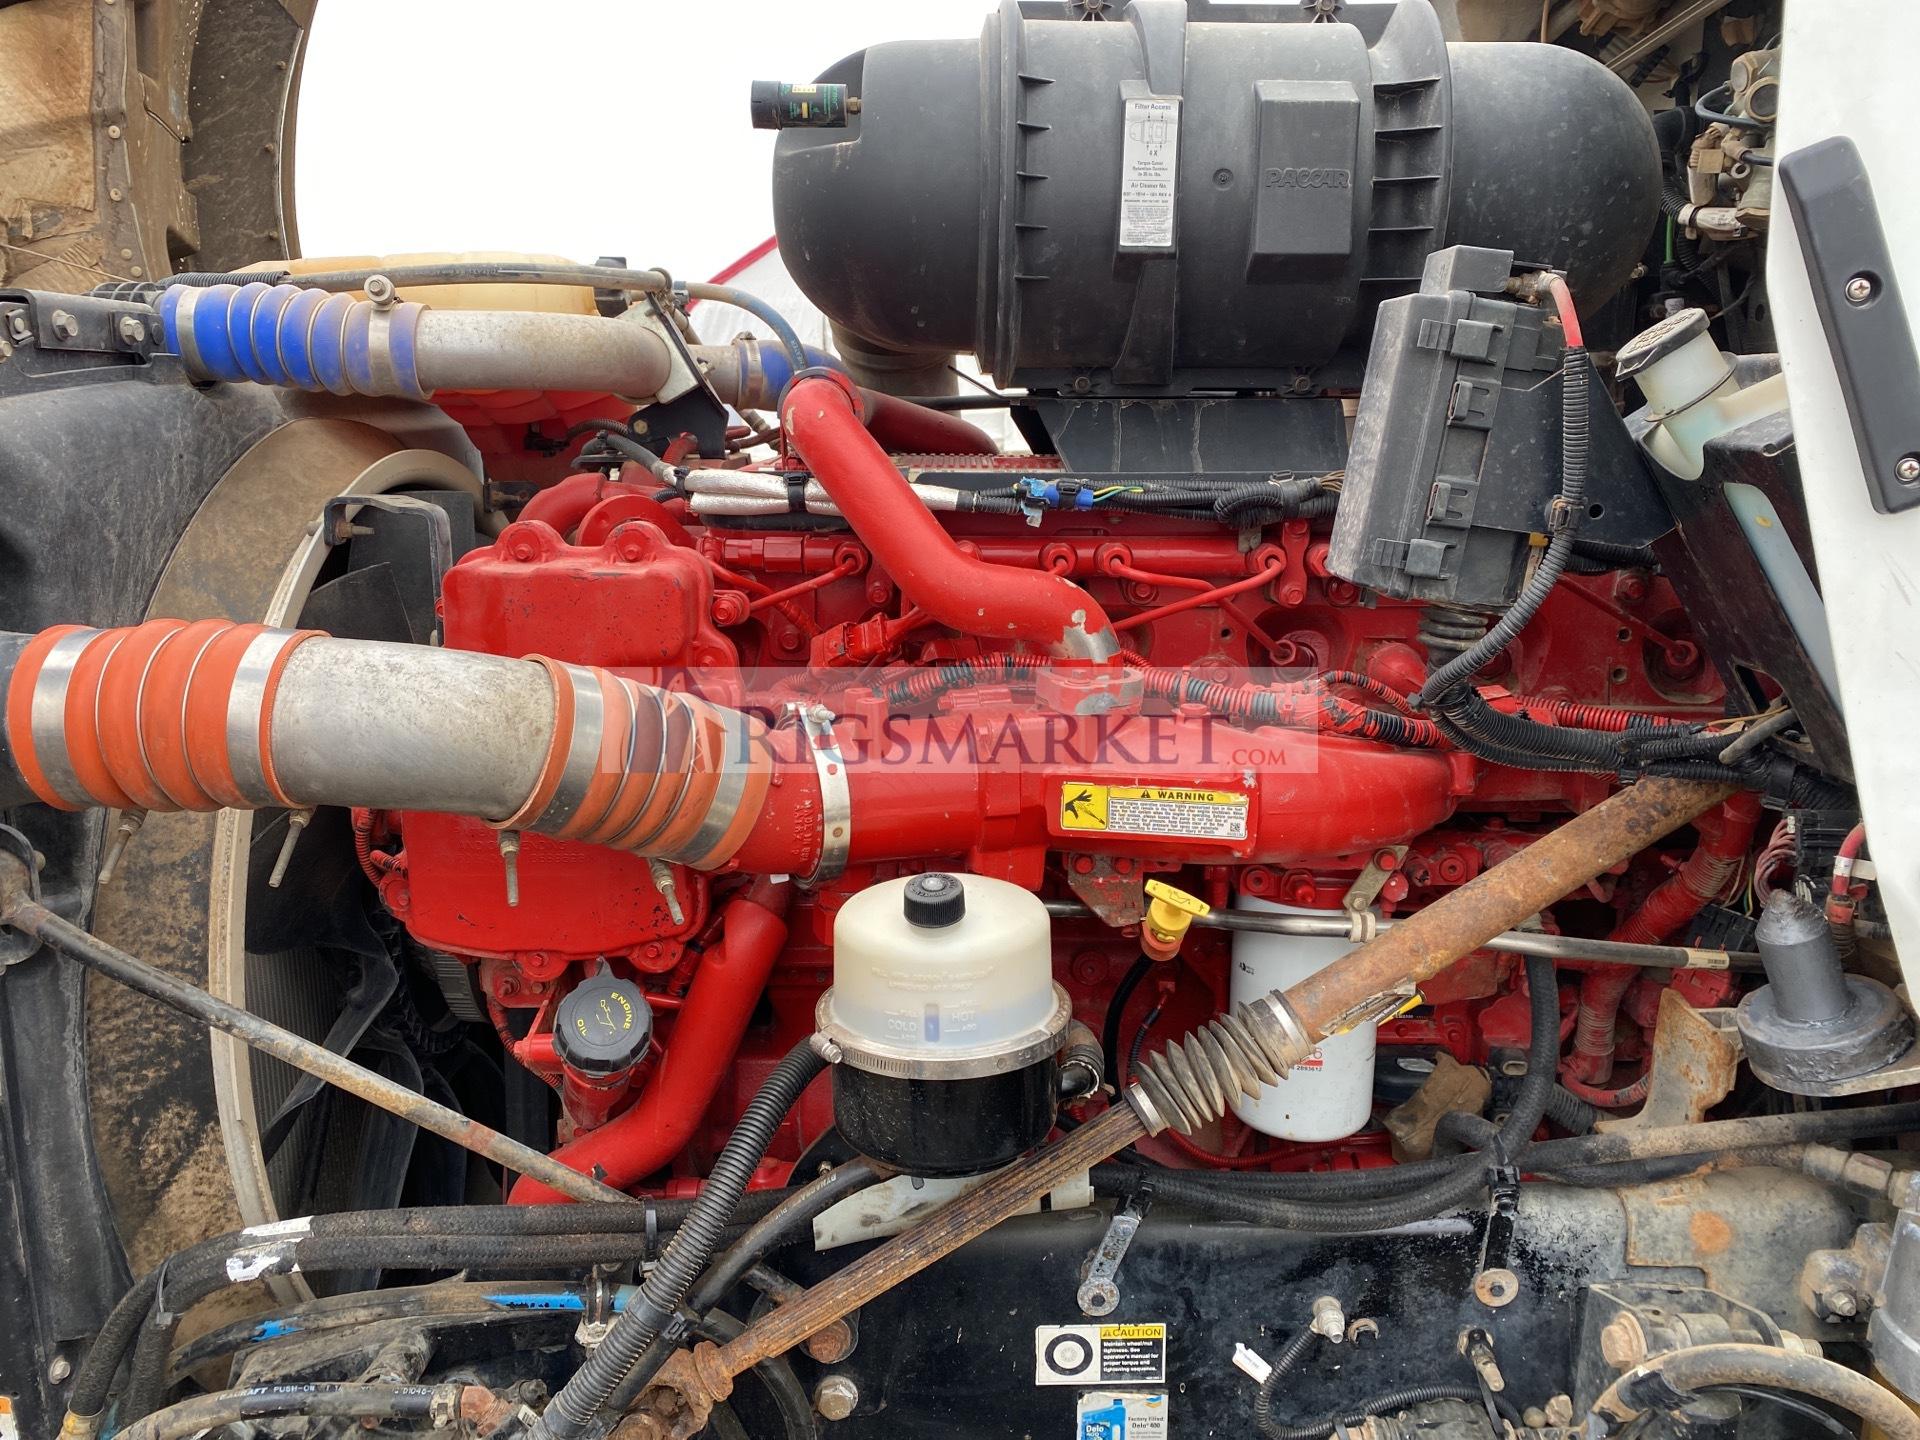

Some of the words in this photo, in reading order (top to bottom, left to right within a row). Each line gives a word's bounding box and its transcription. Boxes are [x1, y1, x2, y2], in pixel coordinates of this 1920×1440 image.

[1134, 102, 1149, 110] Filter
[1150, 103, 1171, 111] Access
[1264, 167, 1351, 188] PACCAR
[1158, 790, 1214, 801] WARNING
[611, 992, 632, 1030] ENGINE
[577, 1018, 588, 1036] OIL
[887, 1018, 917, 1032] COLD
[951, 1010, 976, 1023] HOT
[1112, 1328, 1161, 1337] CAUTION
[1086, 1424, 1104, 1432] Delo
